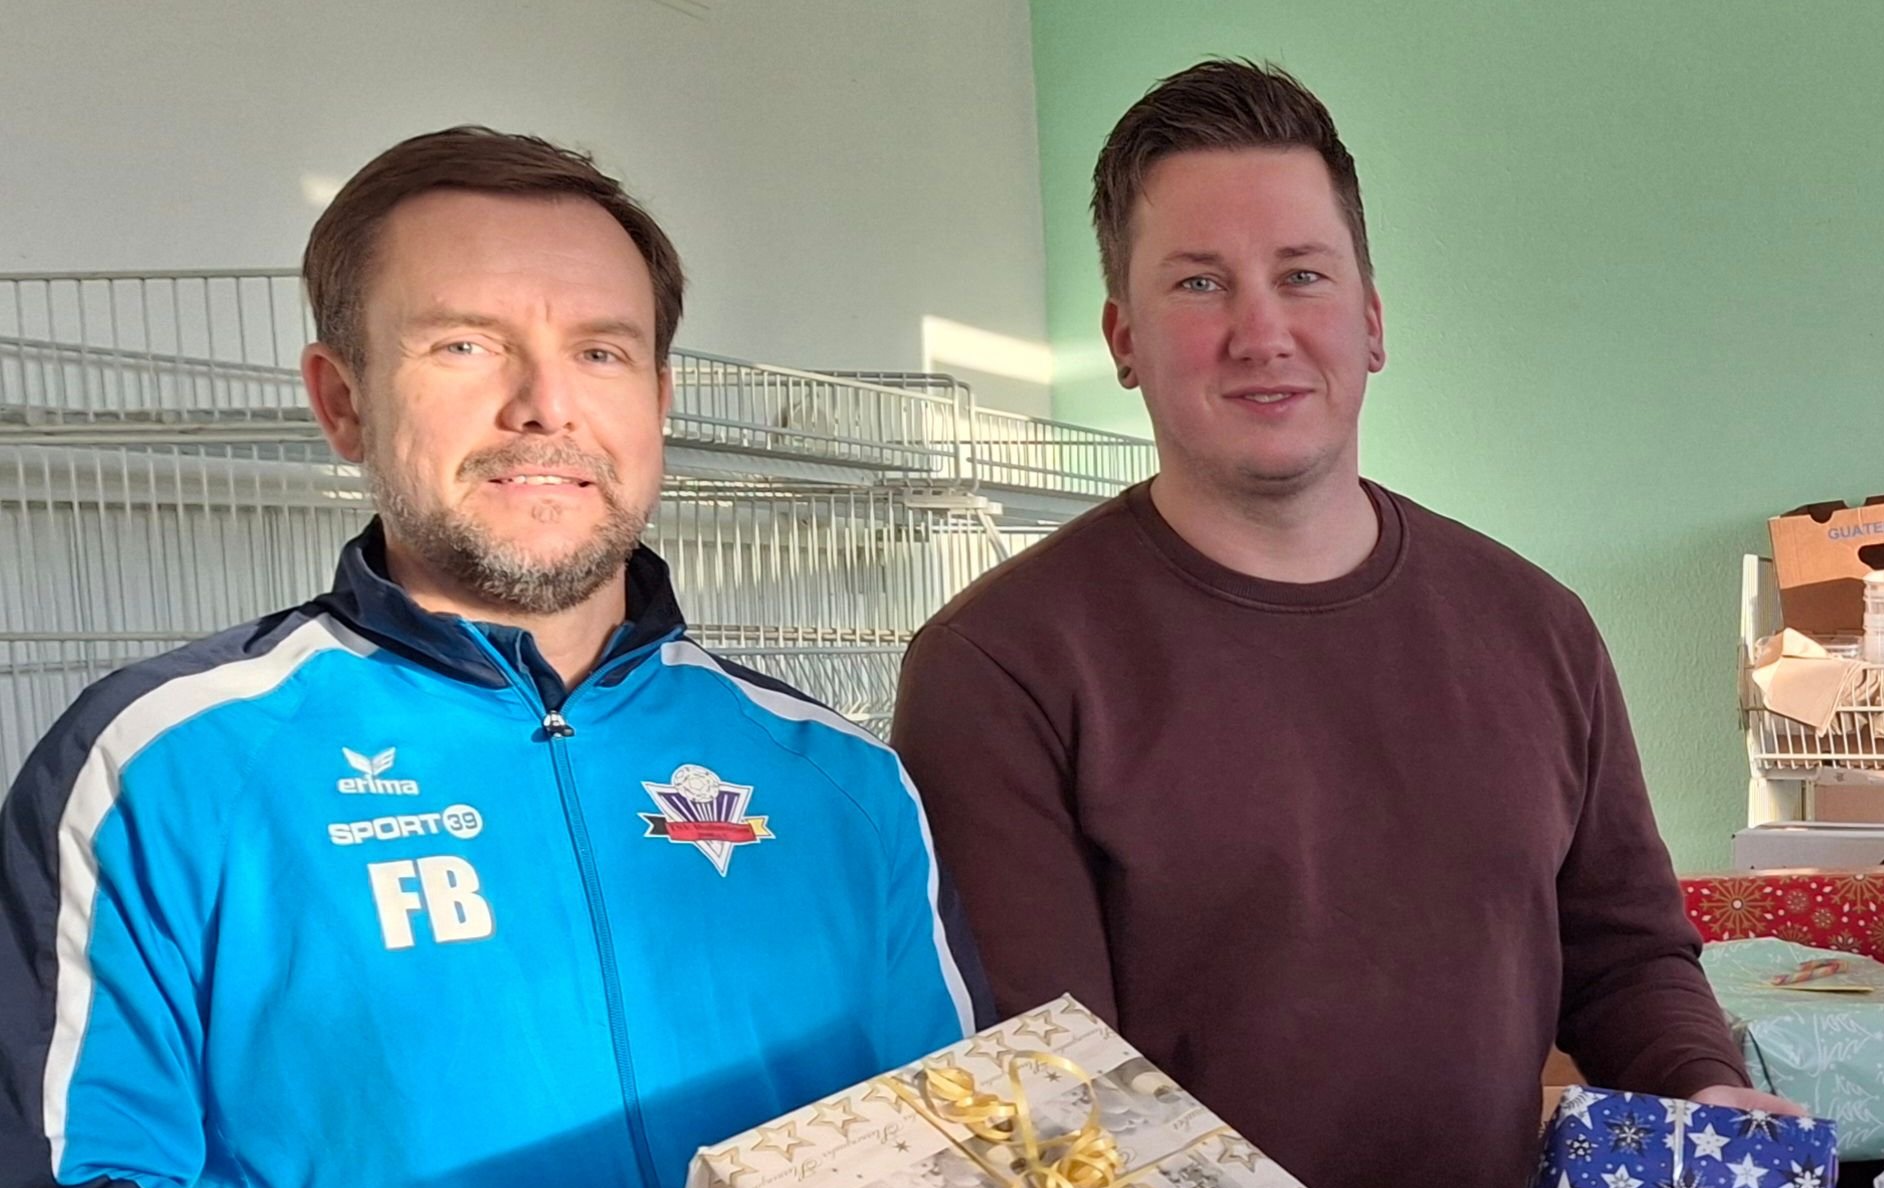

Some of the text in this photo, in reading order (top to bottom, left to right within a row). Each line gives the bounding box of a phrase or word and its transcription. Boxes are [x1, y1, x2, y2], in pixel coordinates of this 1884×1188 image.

[336, 774, 420, 796] erima
[327, 808, 479, 846] SPORT 39
[367, 855, 495, 951] FB
